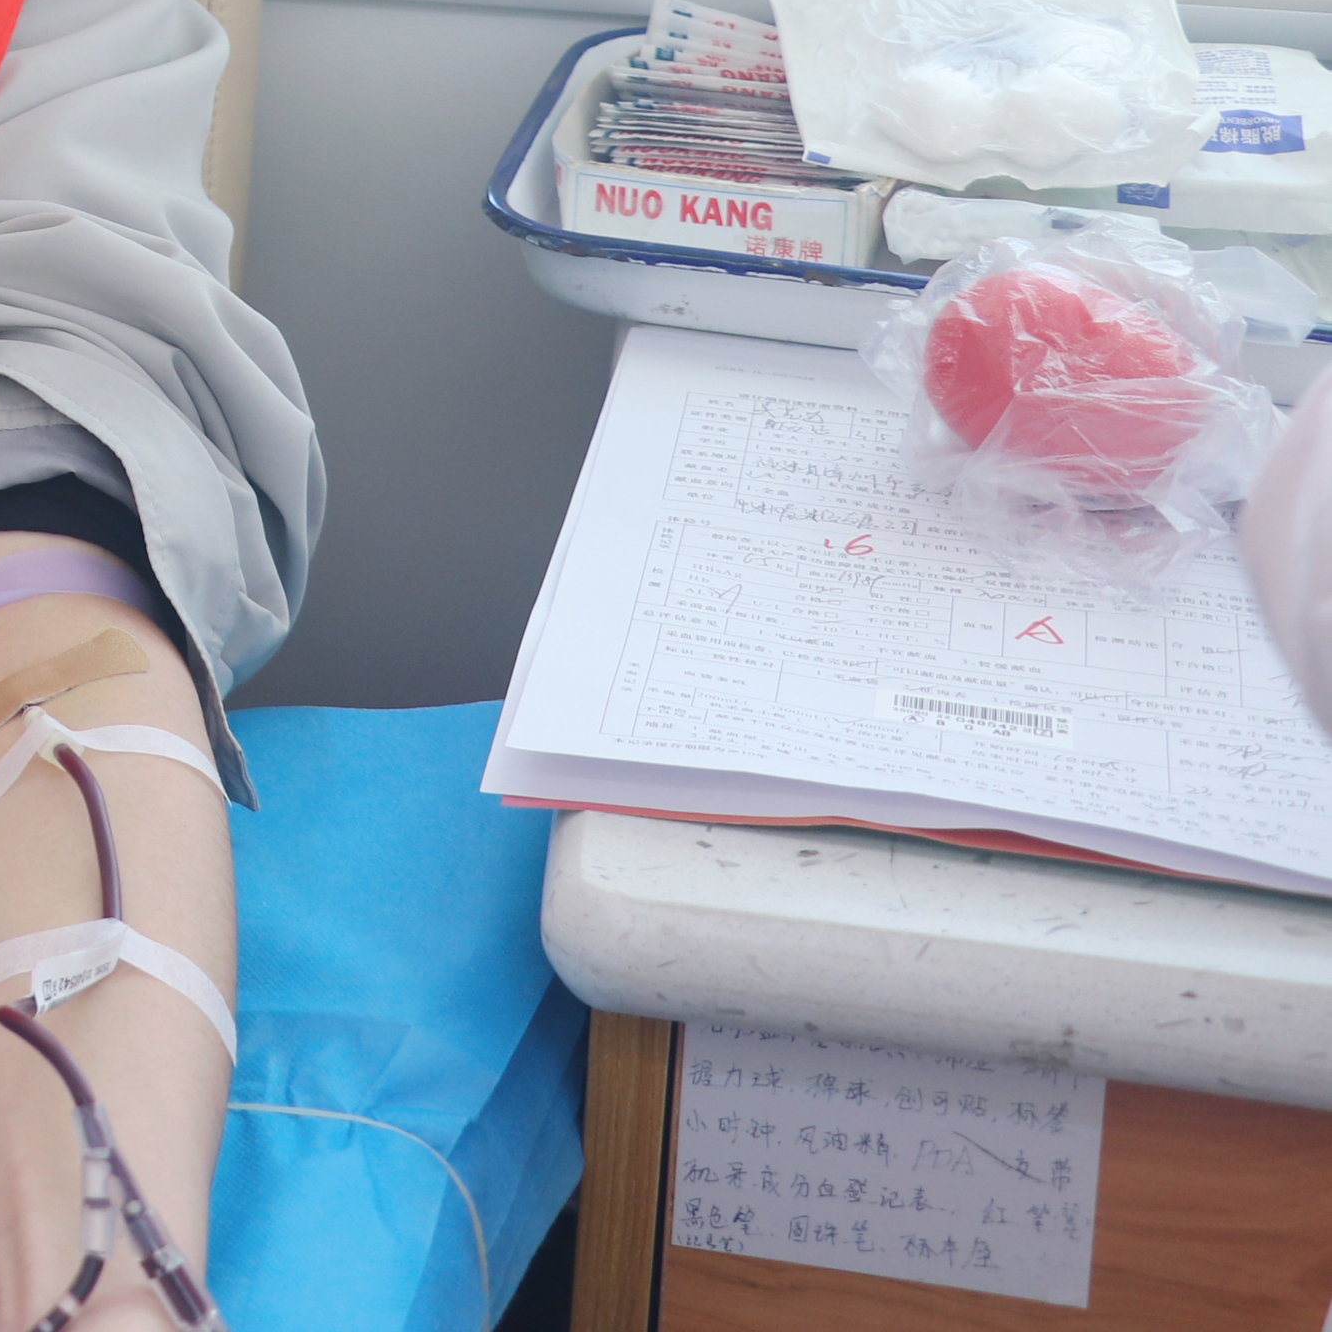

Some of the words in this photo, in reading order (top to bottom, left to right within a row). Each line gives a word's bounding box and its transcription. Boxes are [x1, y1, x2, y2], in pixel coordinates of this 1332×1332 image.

[1210, 124, 1282, 146] 脱脂棉
[595, 182, 664, 219] NUO
[680, 194, 774, 231] KANG
[745, 234, 824, 261] 诺康牌
[992, 728, 1011, 737] AB
